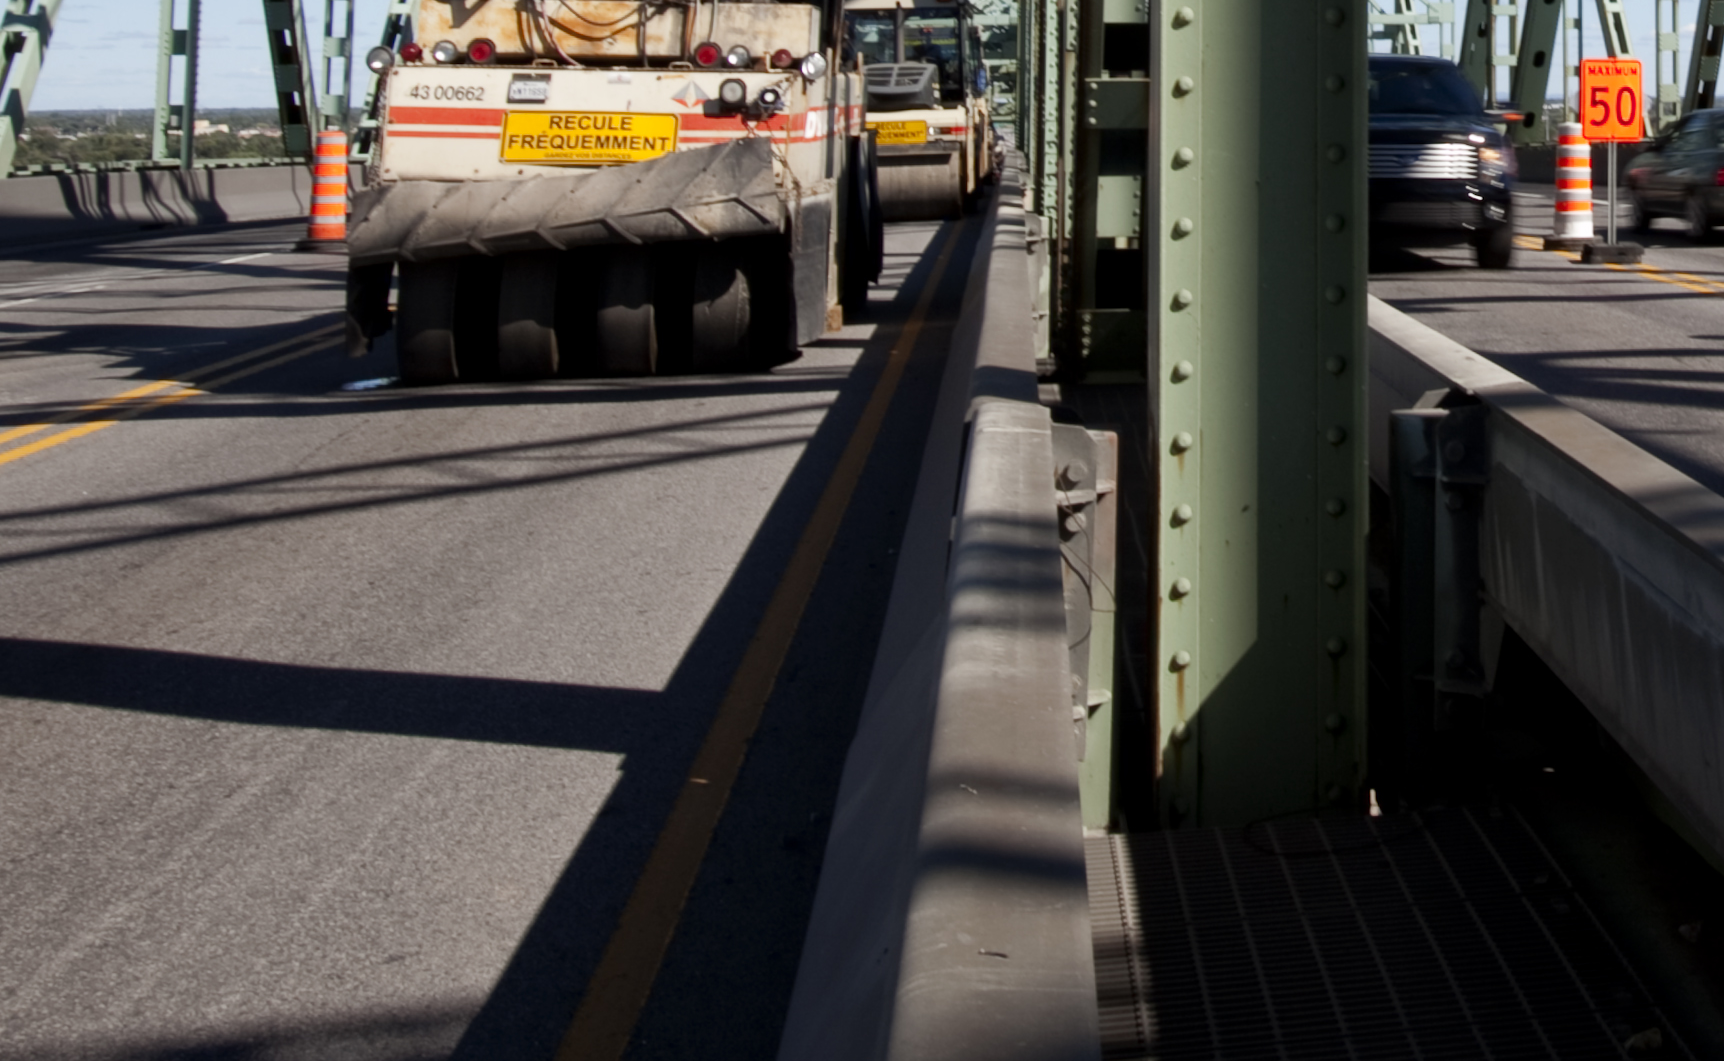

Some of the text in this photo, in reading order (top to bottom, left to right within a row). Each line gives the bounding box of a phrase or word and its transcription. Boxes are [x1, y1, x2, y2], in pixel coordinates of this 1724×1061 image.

[1588, 66, 1637, 75] MAXIMUM
[410, 85, 485, 101] 43 00662
[1590, 86, 1637, 127] 50
[549, 115, 633, 131] RECULE
[508, 131, 670, 151] FRÉQUEMMENT
